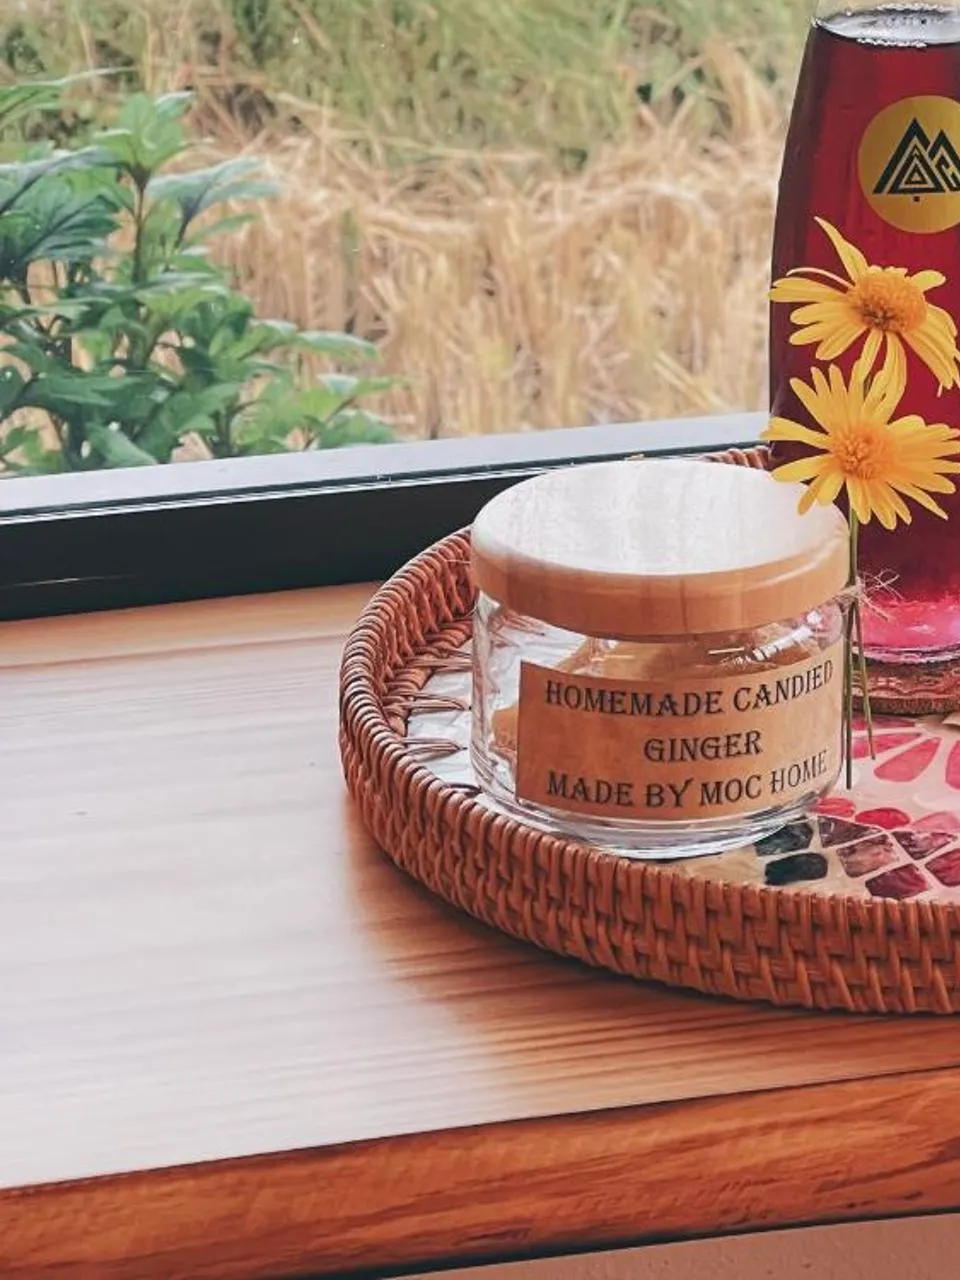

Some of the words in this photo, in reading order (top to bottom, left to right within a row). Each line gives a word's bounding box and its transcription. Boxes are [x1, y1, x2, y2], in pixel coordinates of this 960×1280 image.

[545, 680, 724, 718] HOMEMADE
[732, 658, 834, 710] CANDIED
[643, 729, 763, 763] GINGER
[546, 770, 633, 809] MADE
[645, 777, 694, 809] BY
[699, 772, 763, 806] MOC
[769, 748, 828, 793] HOME
